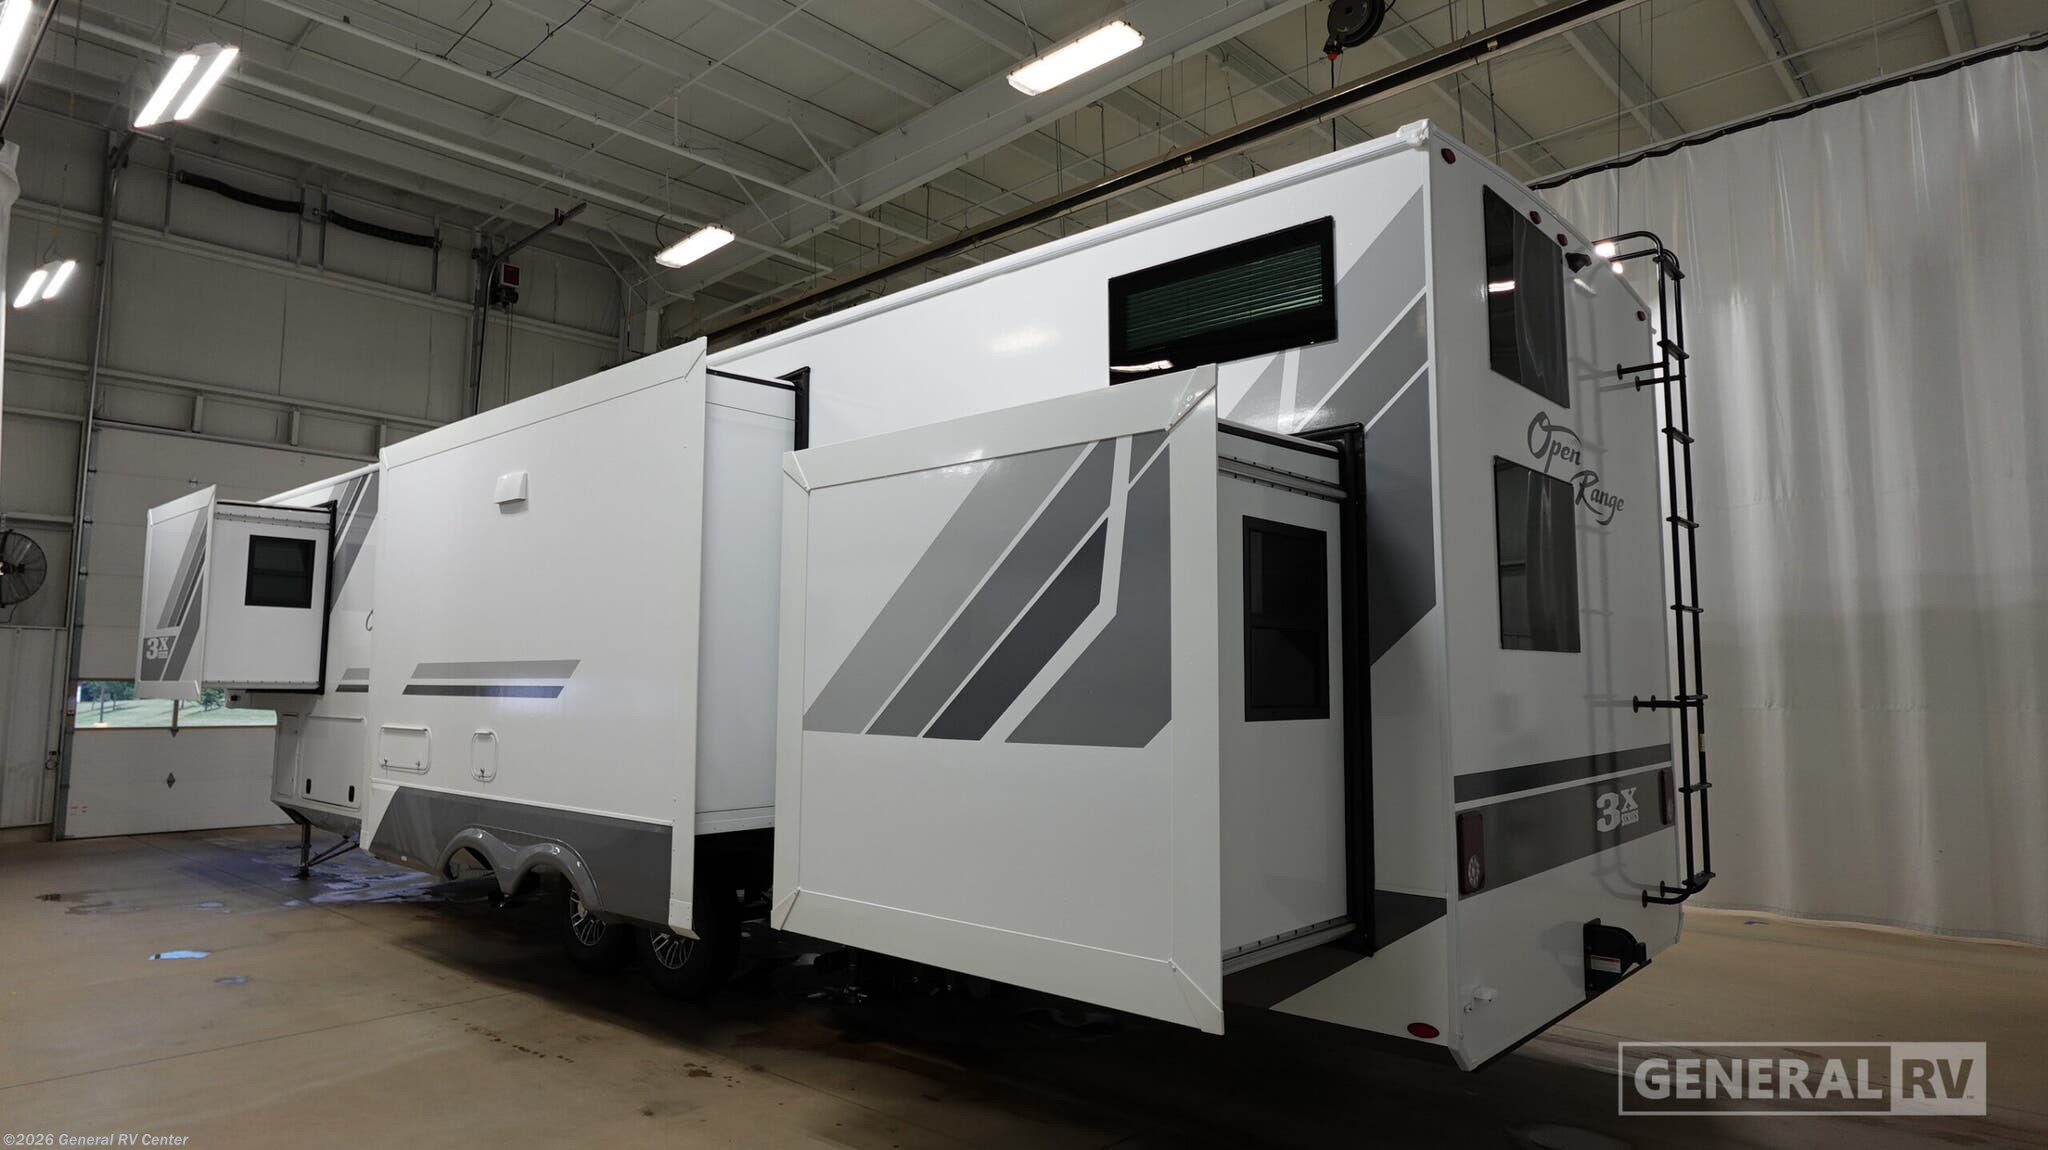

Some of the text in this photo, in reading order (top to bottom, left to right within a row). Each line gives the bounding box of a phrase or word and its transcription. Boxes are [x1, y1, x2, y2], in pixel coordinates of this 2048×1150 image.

[1527, 411, 1582, 473] Open
[1570, 470, 1625, 525] Range
[1596, 787, 1638, 832] 3X
